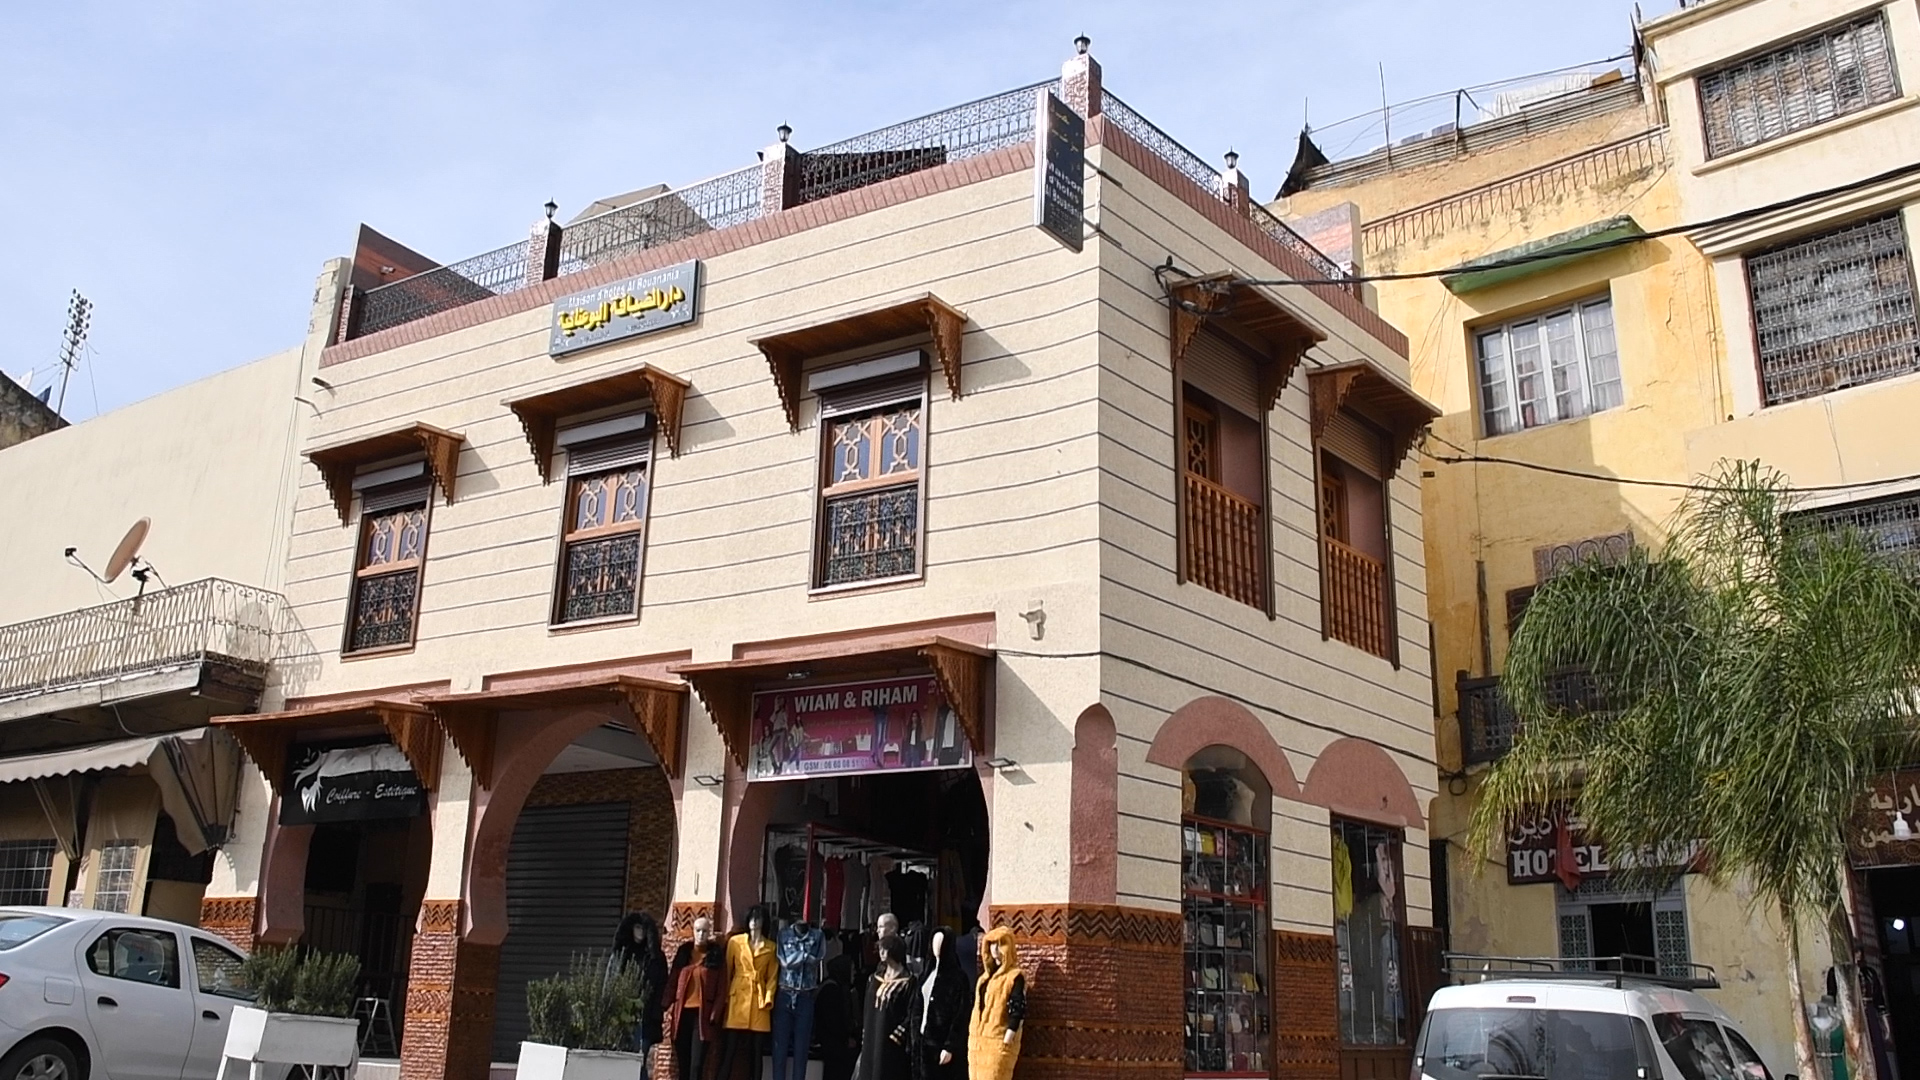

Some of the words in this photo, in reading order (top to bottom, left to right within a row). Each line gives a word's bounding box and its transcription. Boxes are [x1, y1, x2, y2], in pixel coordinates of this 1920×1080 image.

[1046, 159, 1083, 195] Maison
[569, 294, 596, 308] Maison
[794, 691, 840, 713] WIAM
[843, 690, 857, 709] &
[861, 684, 918, 708] RIHAM
[804, 761, 819, 771] GSM
[326, 787, 362, 805] Coiffure
